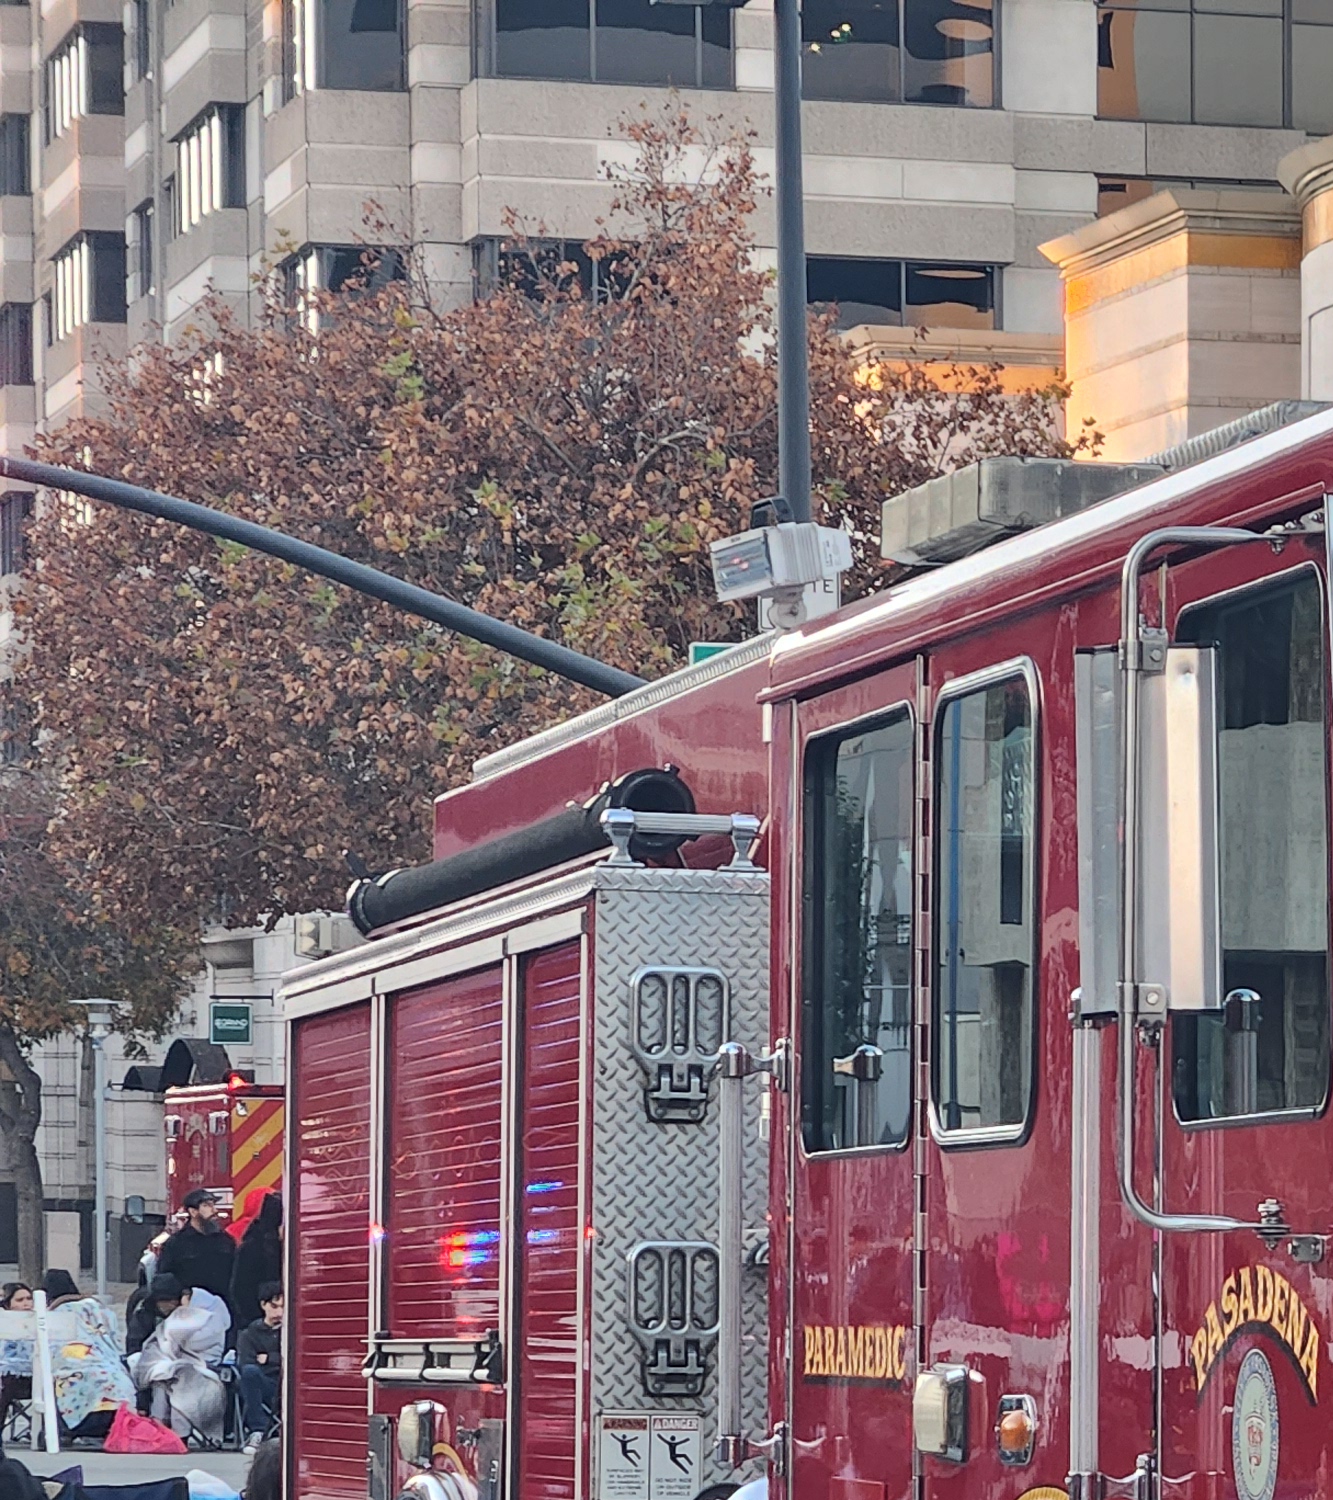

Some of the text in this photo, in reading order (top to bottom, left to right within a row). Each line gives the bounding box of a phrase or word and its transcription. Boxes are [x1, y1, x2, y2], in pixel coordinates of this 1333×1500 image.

[803, 1325, 907, 1380] PARAMEDIC
[1191, 1264, 1320, 1401] PASADENA
[662, 1418, 698, 1430] DANGER
